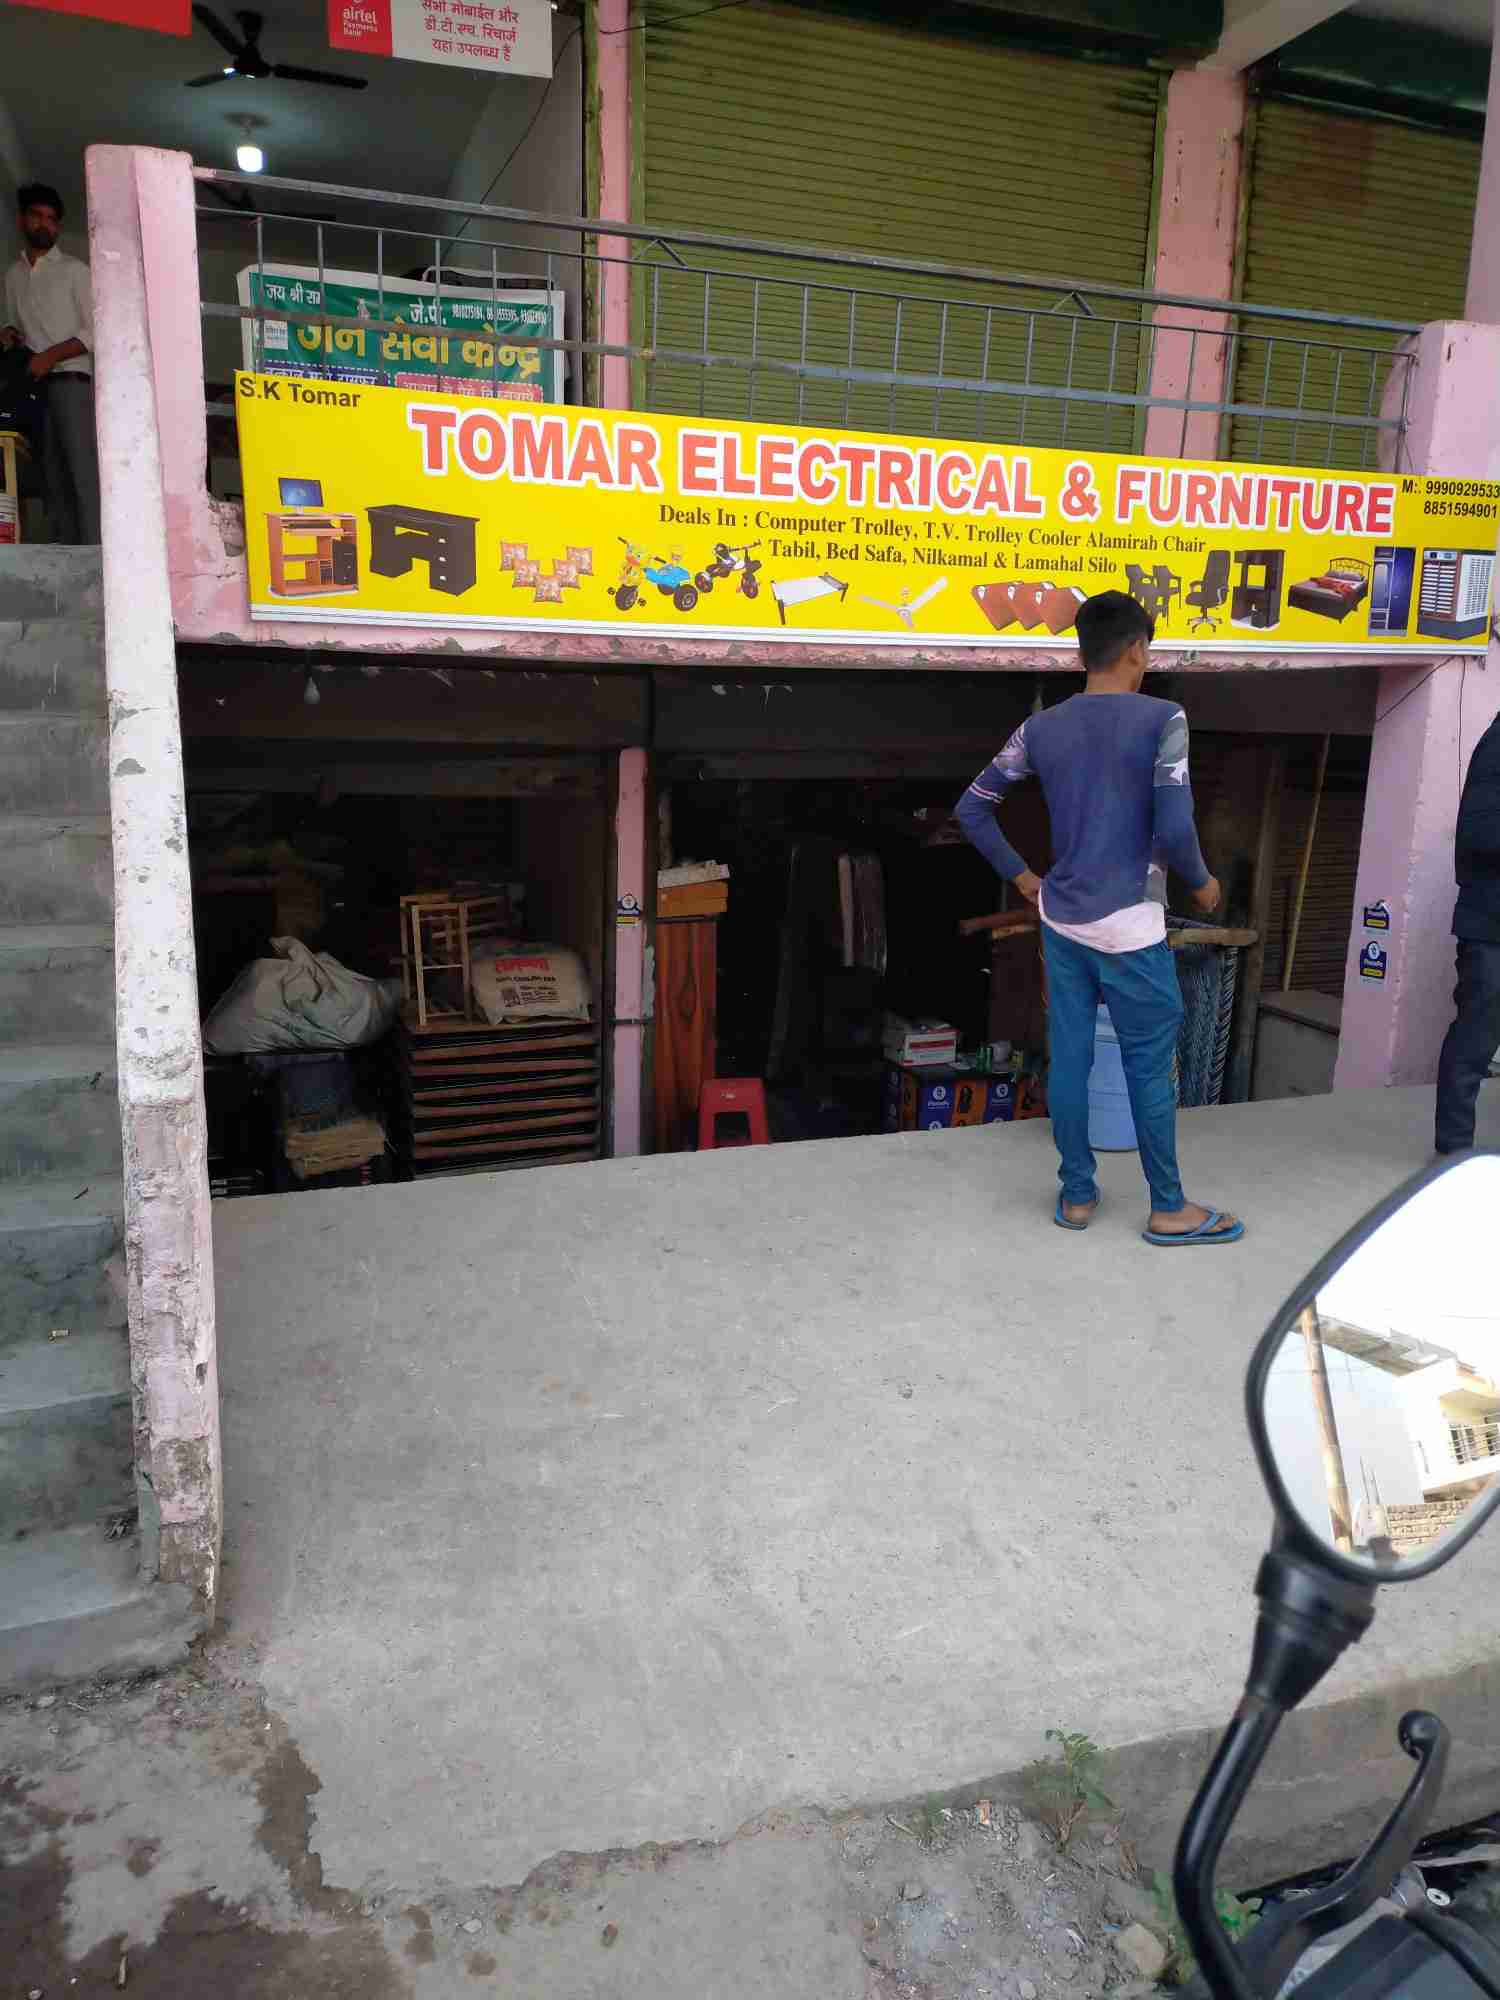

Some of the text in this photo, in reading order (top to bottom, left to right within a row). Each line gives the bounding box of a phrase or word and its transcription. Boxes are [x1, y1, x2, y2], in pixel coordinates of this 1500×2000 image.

[343, 6, 376, 24] airtel
[499, 6, 519, 23] और
[481, 23, 517, 42] रिचार्ज
[456, 42, 499, 59] उपलब्ध
[265, 283, 285, 301] जय
[289, 281, 304, 303] श्री
[239, 377, 361, 408] S.K Tomar
[408, 407, 1396, 535] TOMAR ELECTRICAL & FURNITURE
[1425, 480, 1500, 499] 9990929533
[1423, 500, 1497, 518] 8851594901
[658, 504, 711, 525] Deals
[717, 508, 736, 527] In
[754, 510, 847, 535] Computer
[851, 516, 918, 541] Trolley,
[923, 521, 959, 540] T.V.
[966, 524, 1023, 547] Trolley
[1028, 528, 1081, 548] Cooler
[1086, 531, 1158, 551] Alamirah
[1163, 535, 1206, 553] Chair
[768, 539, 1118, 574] Tabil, Bed Safa, Nilkamal & Lamahal Silo
